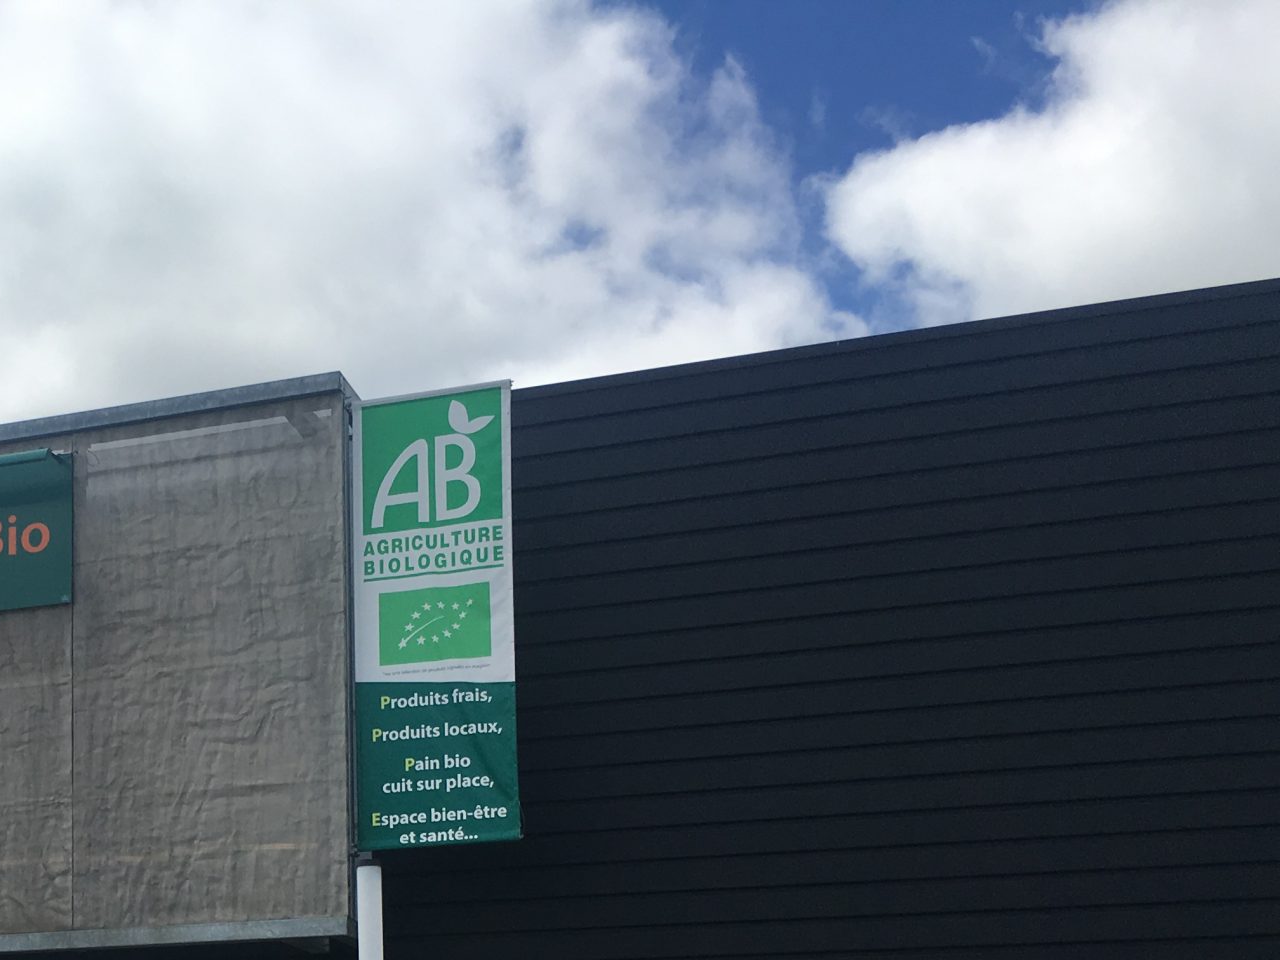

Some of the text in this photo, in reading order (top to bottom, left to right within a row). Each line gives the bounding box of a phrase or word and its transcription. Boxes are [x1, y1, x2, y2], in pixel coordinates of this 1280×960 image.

[370, 432, 481, 529] AB
[363, 525, 504, 557] AGRICULTURE
[363, 546, 504, 576] BIOLOGIQUE
[380, 688, 493, 710] Produits frais,
[372, 721, 503, 742] Produits locaux,
[404, 754, 471, 772] Pain bio
[382, 774, 495, 794] cuit sur place,
[371, 804, 508, 829] Espace bien-être
[399, 830, 416, 844] et
